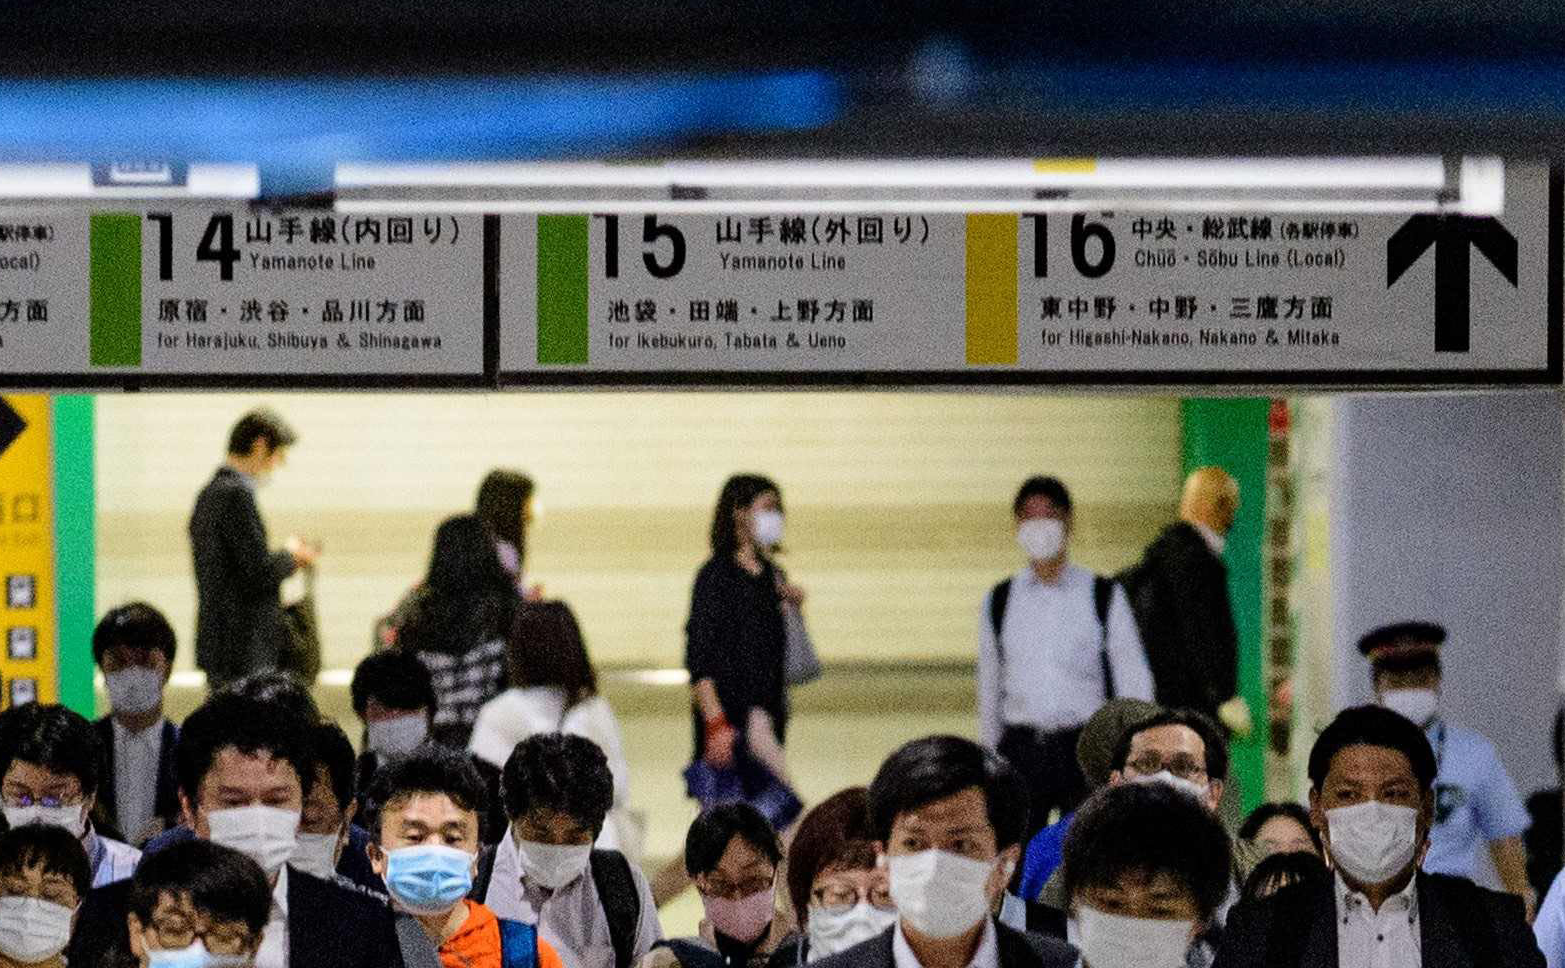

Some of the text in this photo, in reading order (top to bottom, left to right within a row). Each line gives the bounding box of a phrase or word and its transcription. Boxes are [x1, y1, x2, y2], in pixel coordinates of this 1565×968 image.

[147, 213, 241, 281] 14
[593, 214, 686, 278] 15
[1022, 212, 1116, 278] 16
[250, 253, 375, 270] Yamanote Line
[720, 253, 846, 270] Yamanote Line
[1246, 249, 1280, 268] Line
[1287, 249, 1345, 270] (Local)
[158, 333, 179, 348] for
[267, 332, 328, 351] Shibuya
[337, 334, 350, 348] &
[359, 332, 442, 350] Shinagawa
[609, 333, 630, 348] for
[725, 333, 777, 348] Tabata
[786, 334, 800, 348] &
[808, 333, 846, 348] Ueno
[1041, 329, 1061, 344] for
[1199, 329, 1257, 345] Nakano
[1265, 330, 1279, 345] &
[1288, 329, 1340, 345] Mitaka
